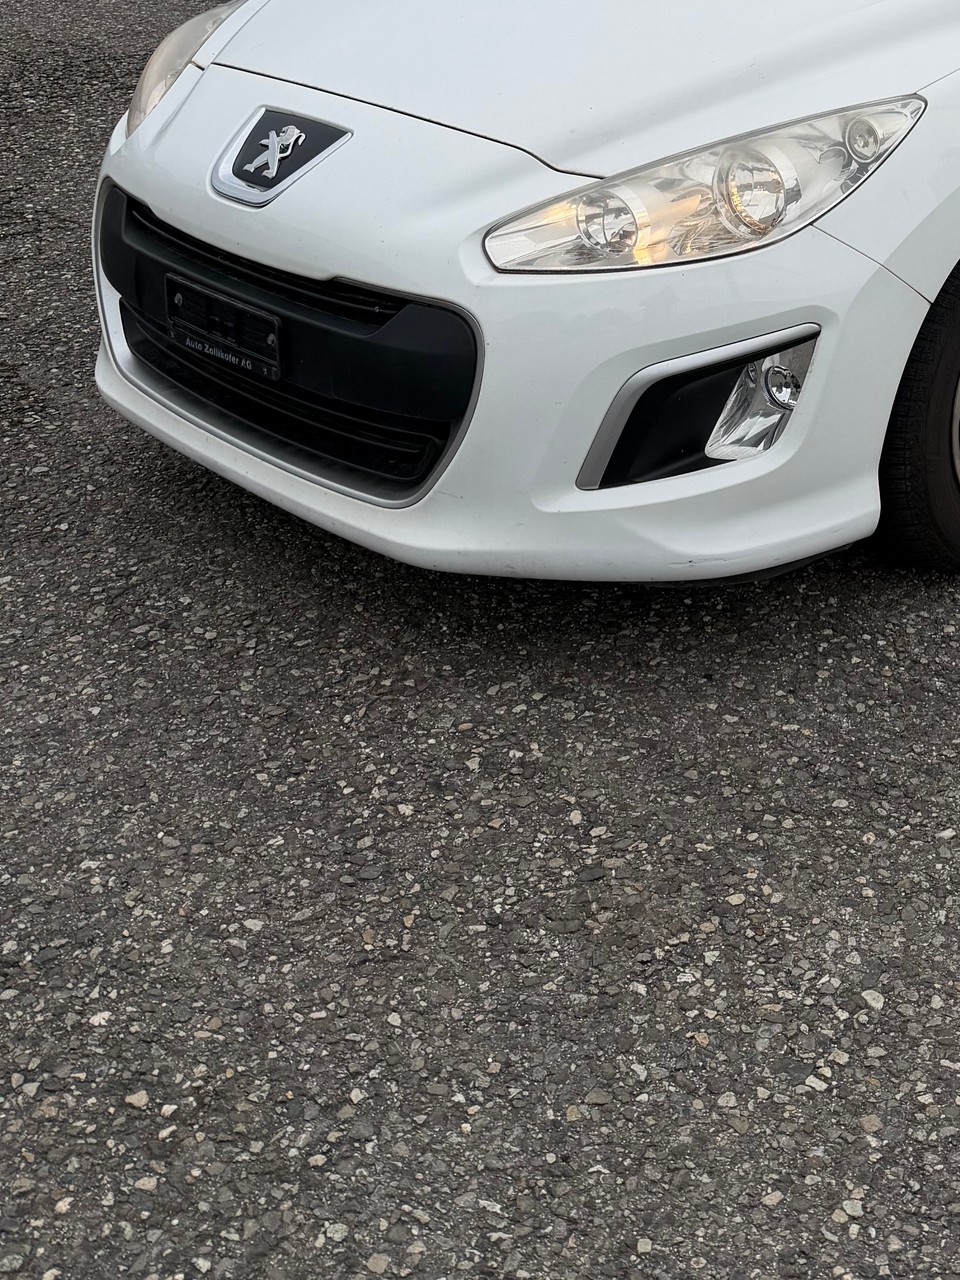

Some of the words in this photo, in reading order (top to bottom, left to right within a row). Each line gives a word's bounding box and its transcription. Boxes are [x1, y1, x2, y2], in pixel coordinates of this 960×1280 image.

[185, 337, 203, 351] Auto
[204, 343, 239, 365] Zollikofer
[240, 358, 252, 370] AG
